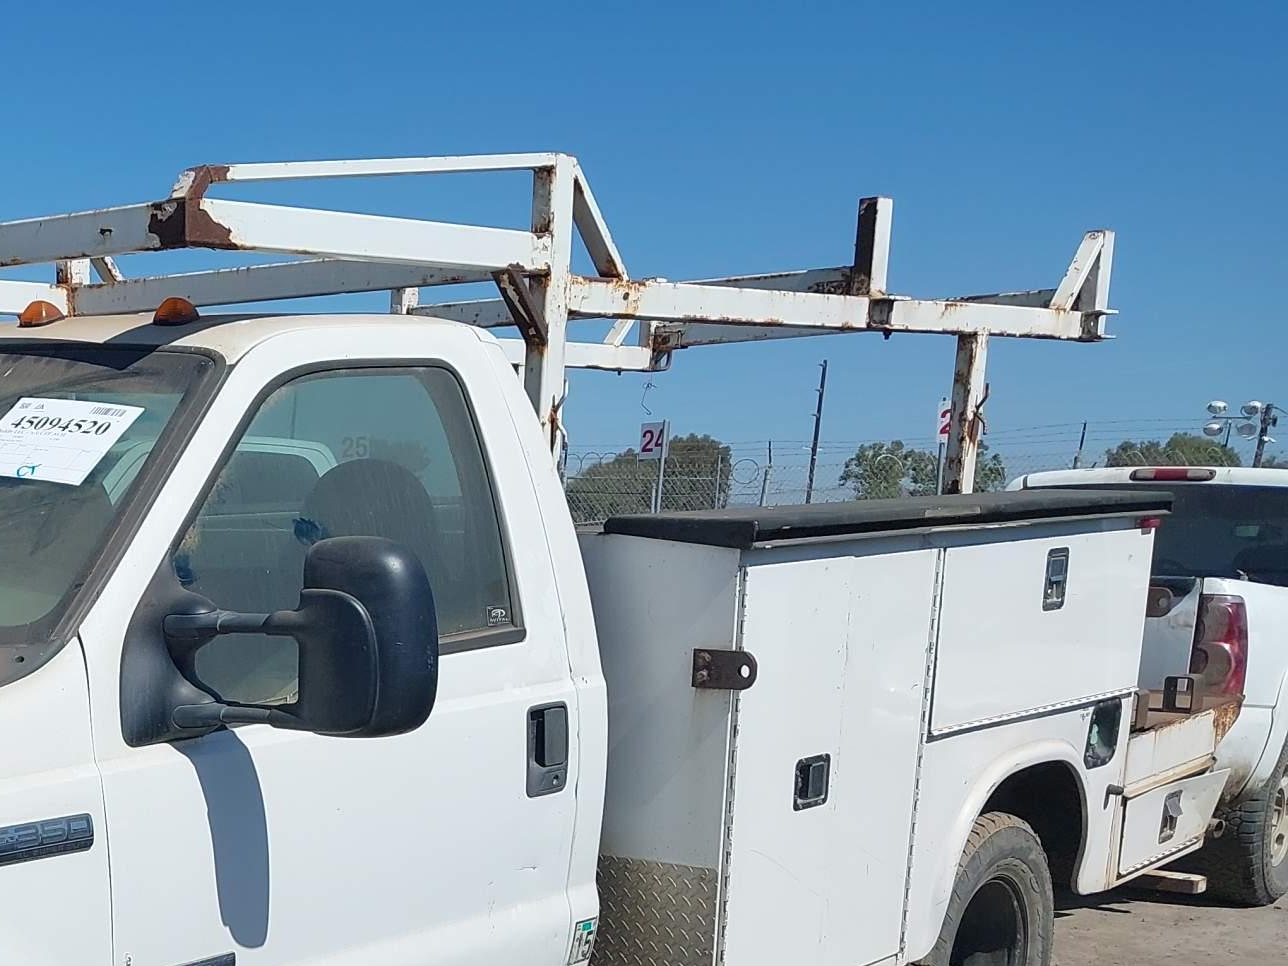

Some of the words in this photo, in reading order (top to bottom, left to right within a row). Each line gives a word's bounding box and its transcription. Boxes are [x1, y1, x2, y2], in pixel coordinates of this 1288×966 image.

[10, 415, 112, 436] 45094520
[939, 408, 953, 435] 2
[641, 428, 663, 453] 24
